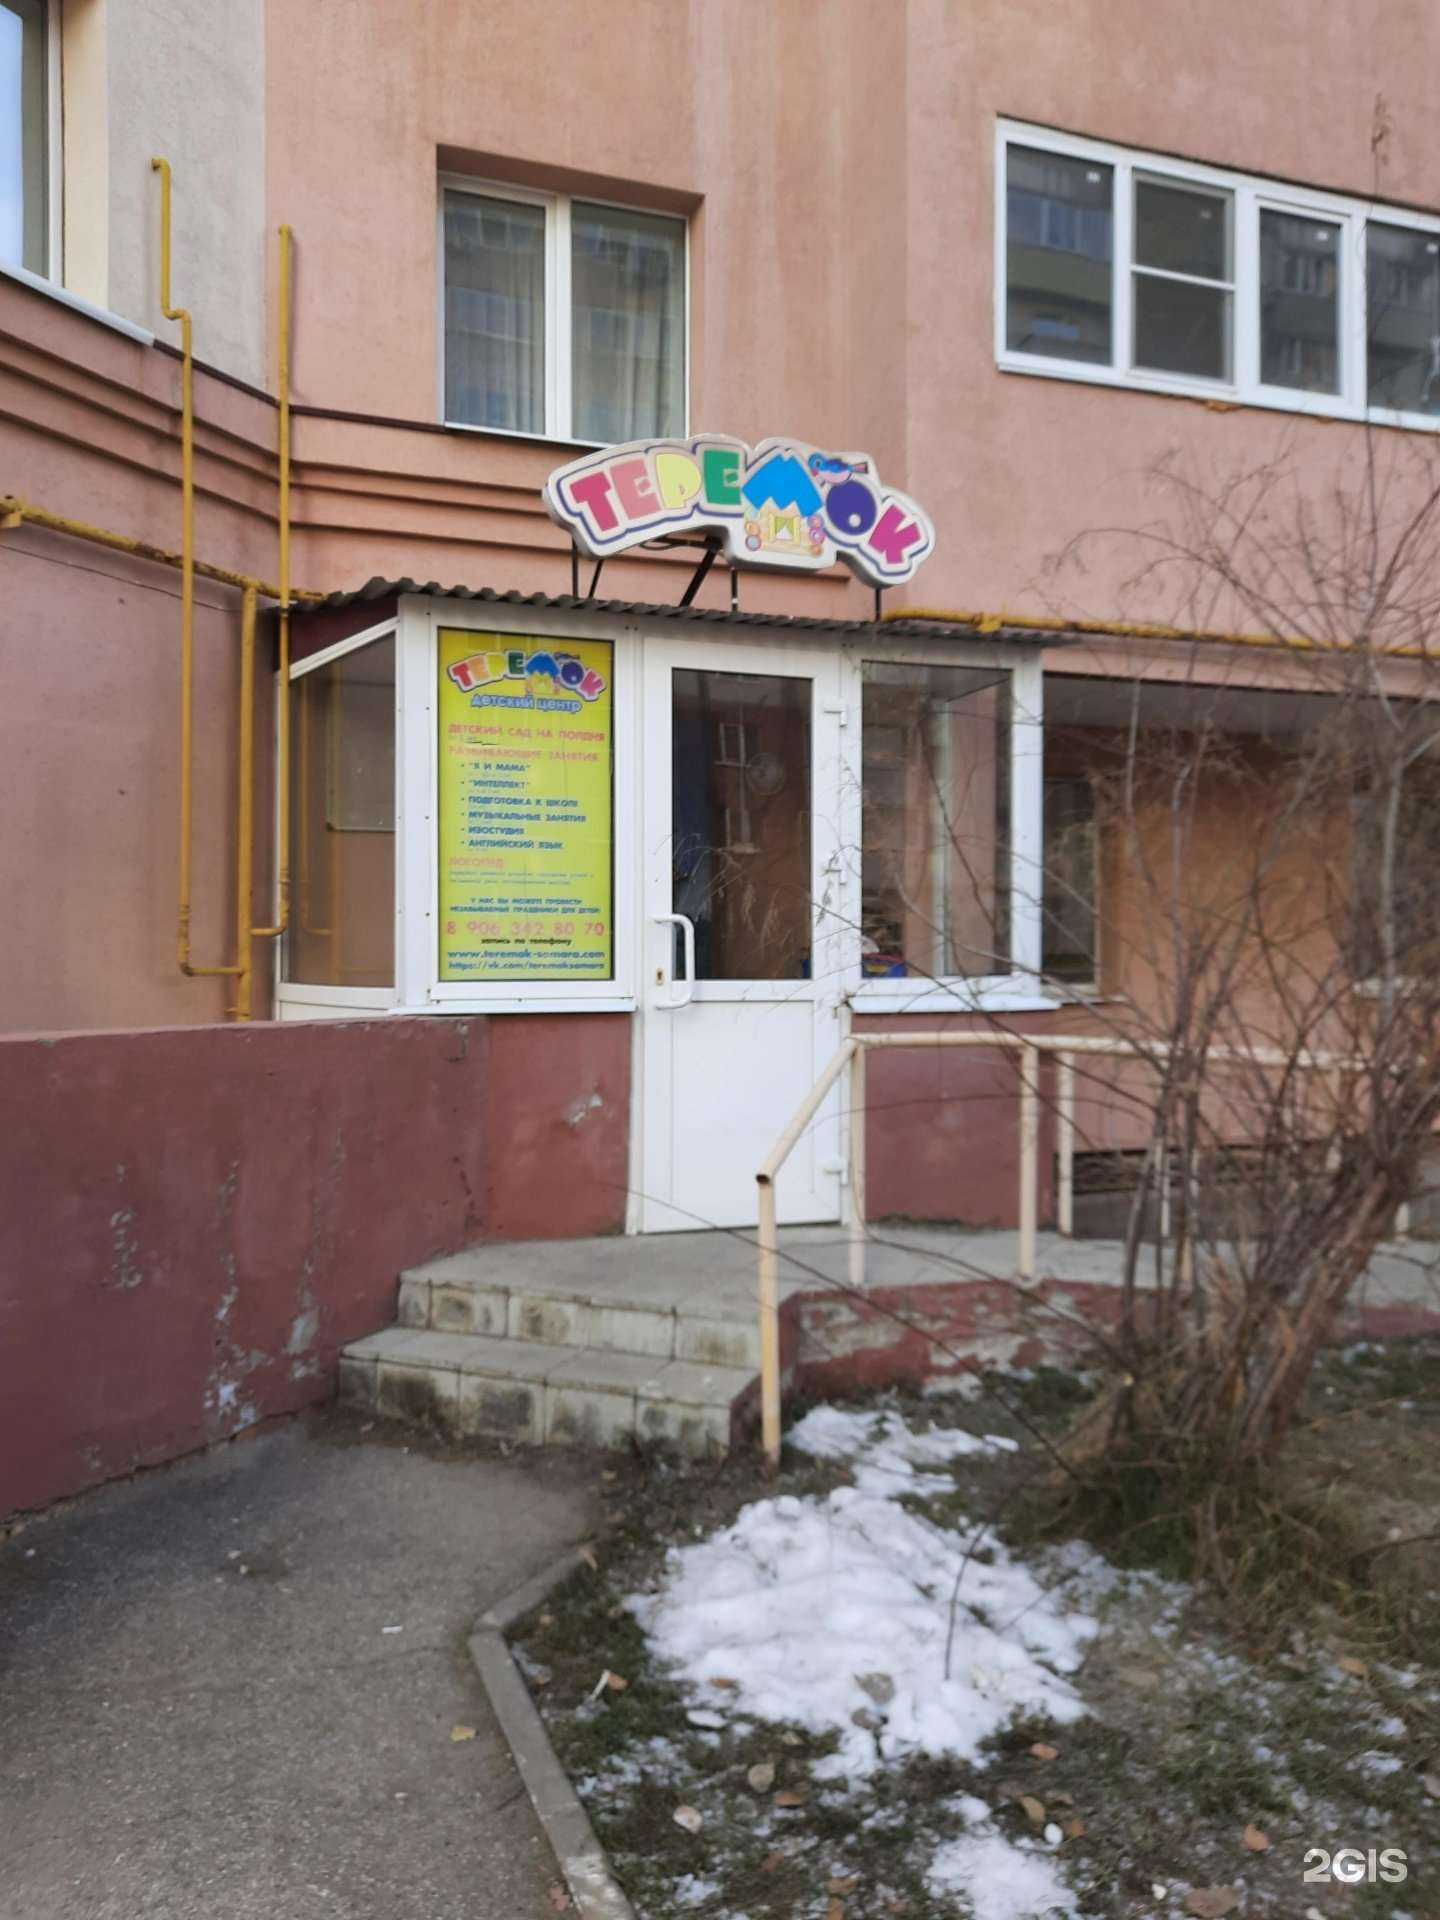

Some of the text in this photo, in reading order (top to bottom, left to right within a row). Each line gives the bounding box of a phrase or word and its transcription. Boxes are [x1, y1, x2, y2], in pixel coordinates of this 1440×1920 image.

[568, 448, 922, 565] ТЕРЕМОК
[536, 698, 583, 714] центр
[448, 724, 503, 737] ДЕТСКИЙ
[508, 727, 532, 739] САД
[537, 728, 553, 739] НА
[468, 796, 578, 808] ПОДГОТОВКА К ШКОЛЕ
[468, 811, 586, 823] МУЗЫКАЛЬНЫЕ ЗАНЯТИЯ
[468, 826, 524, 835] ИЗОСТУДИЯ
[468, 839, 564, 850] АНГЛИЙСКИЙ ЯЗЫК
[447, 921, 457, 935] 8
[466, 921, 501, 936] 906
[553, 922, 576, 936] 80
[584, 922, 605, 937] 70
